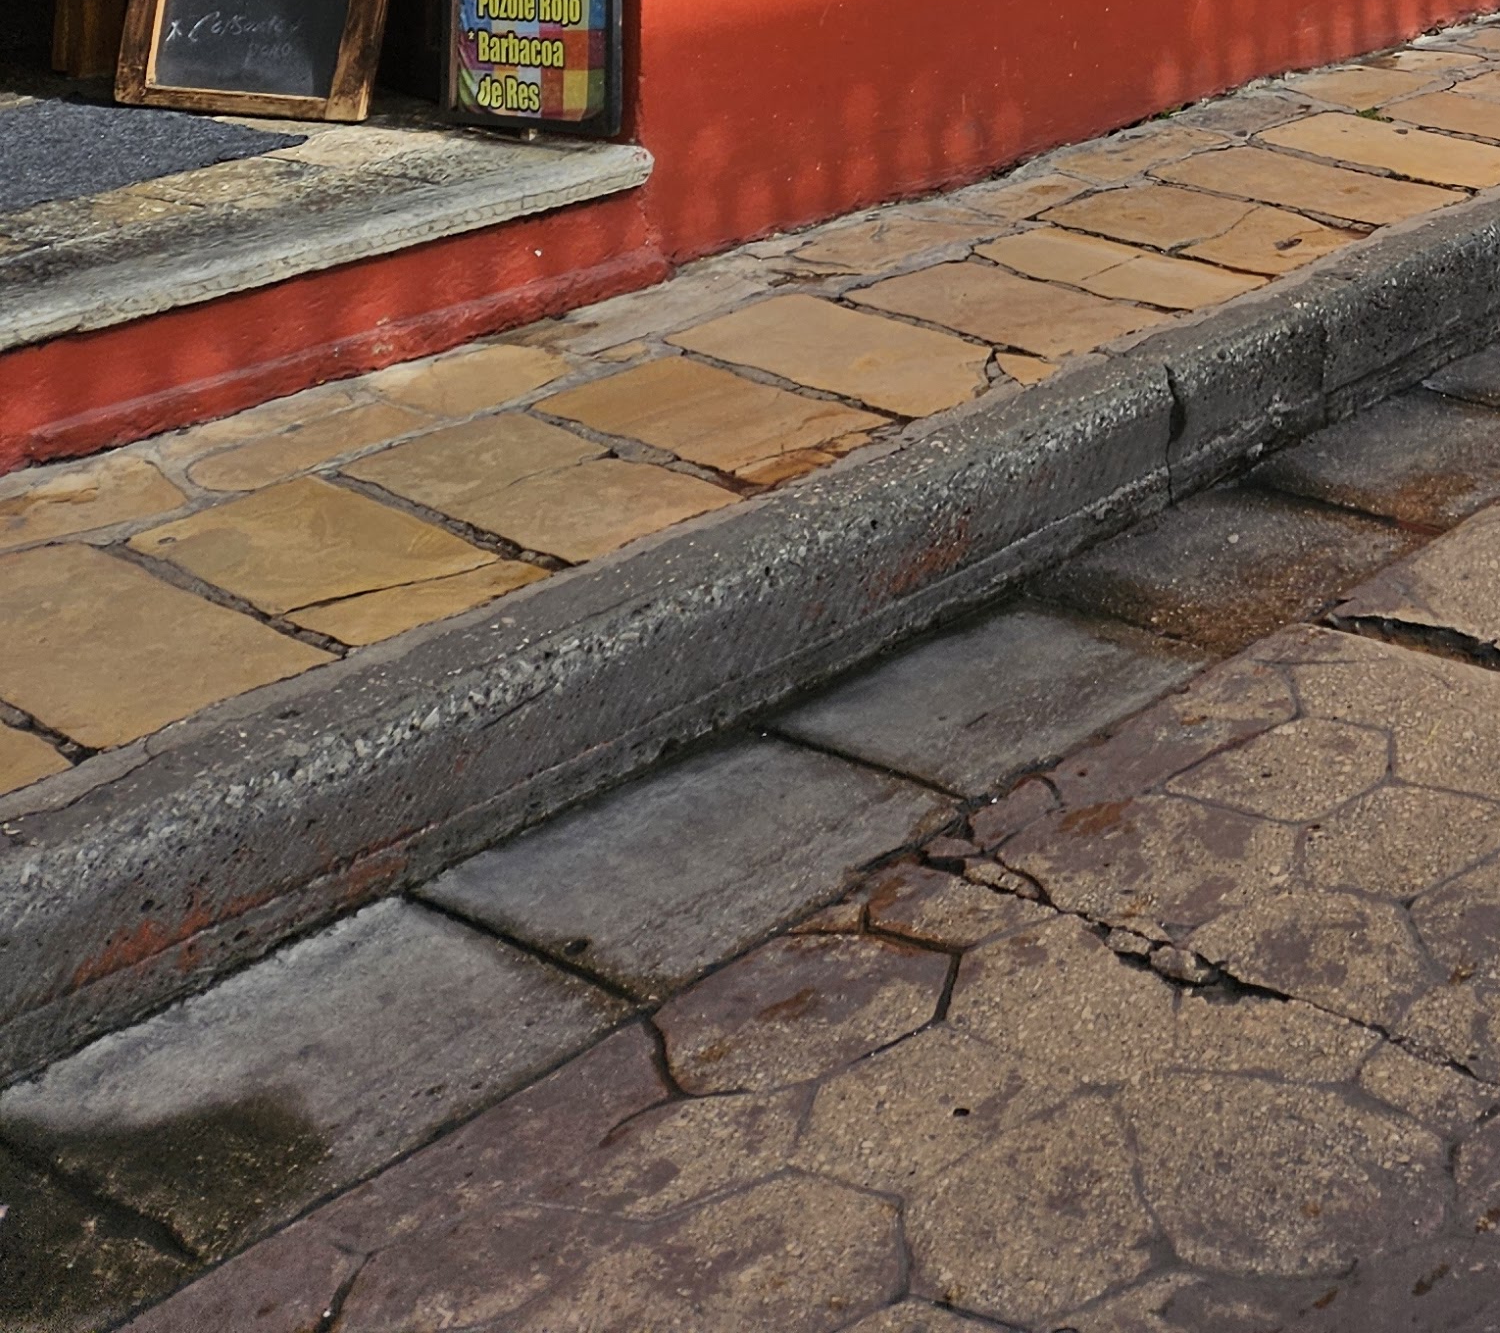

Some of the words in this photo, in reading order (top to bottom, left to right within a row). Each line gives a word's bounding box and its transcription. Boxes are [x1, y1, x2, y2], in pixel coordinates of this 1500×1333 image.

[477, 30, 565, 68] Barbacoa
[477, 75, 502, 107] de
[506, 79, 541, 111] Res
